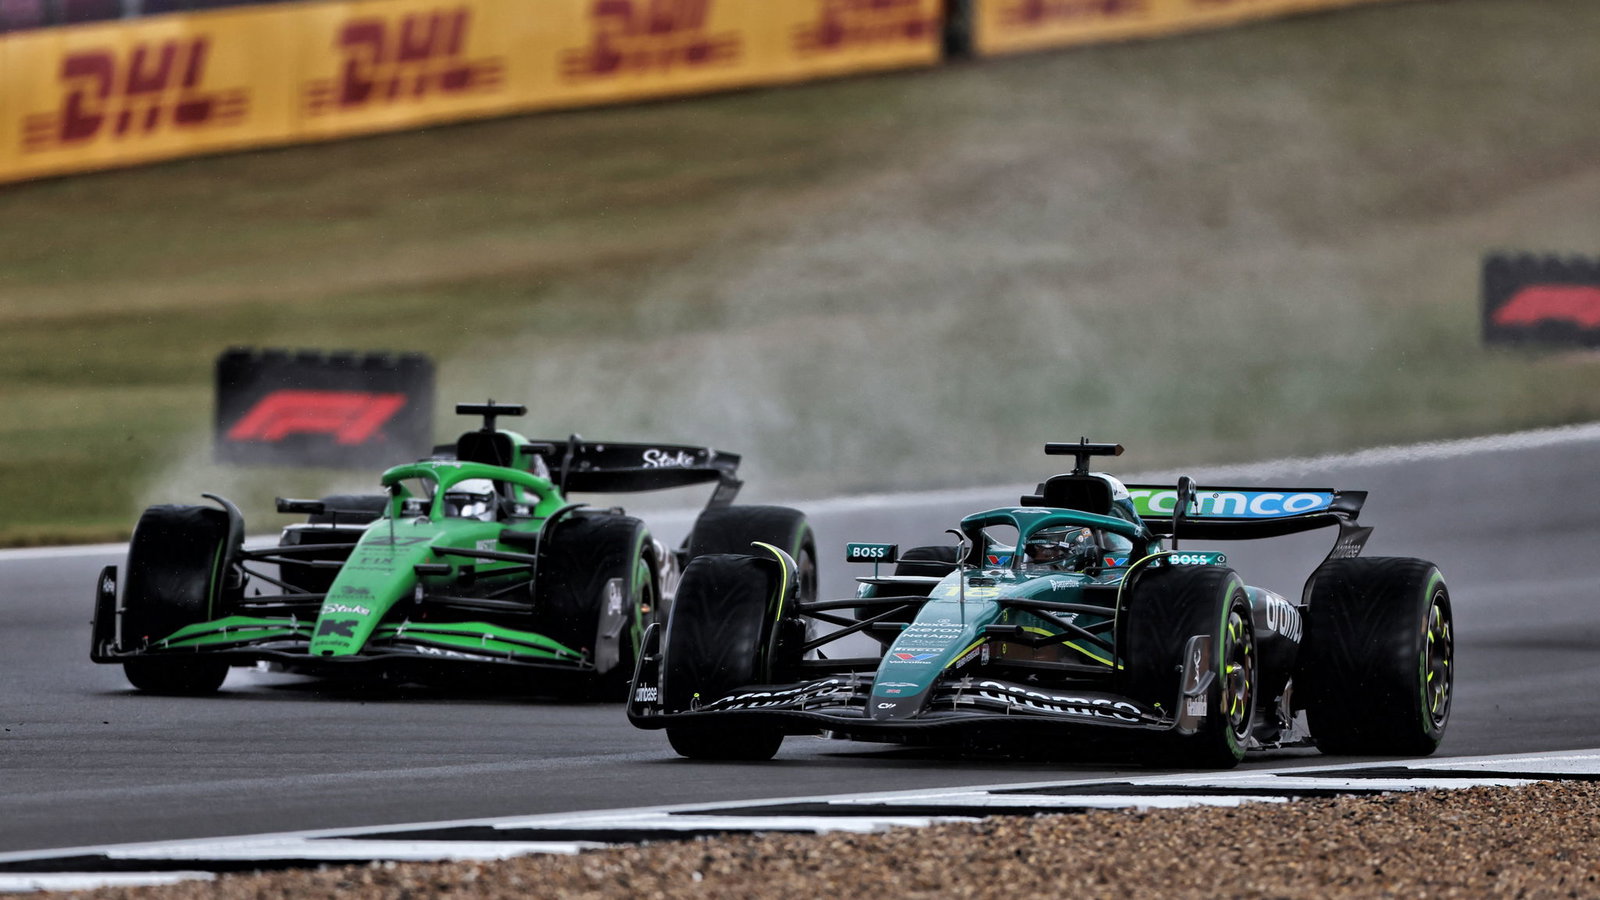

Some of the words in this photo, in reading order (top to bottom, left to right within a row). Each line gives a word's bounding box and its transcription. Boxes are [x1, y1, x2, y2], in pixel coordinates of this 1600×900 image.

[337, 8, 470, 107] DHL
[58, 35, 211, 142] DHL
[1130, 491, 1323, 515] ramco
[852, 546, 884, 558] BOSS
[1171, 554, 1207, 565] BOSS
[979, 681, 1142, 722] aramco
